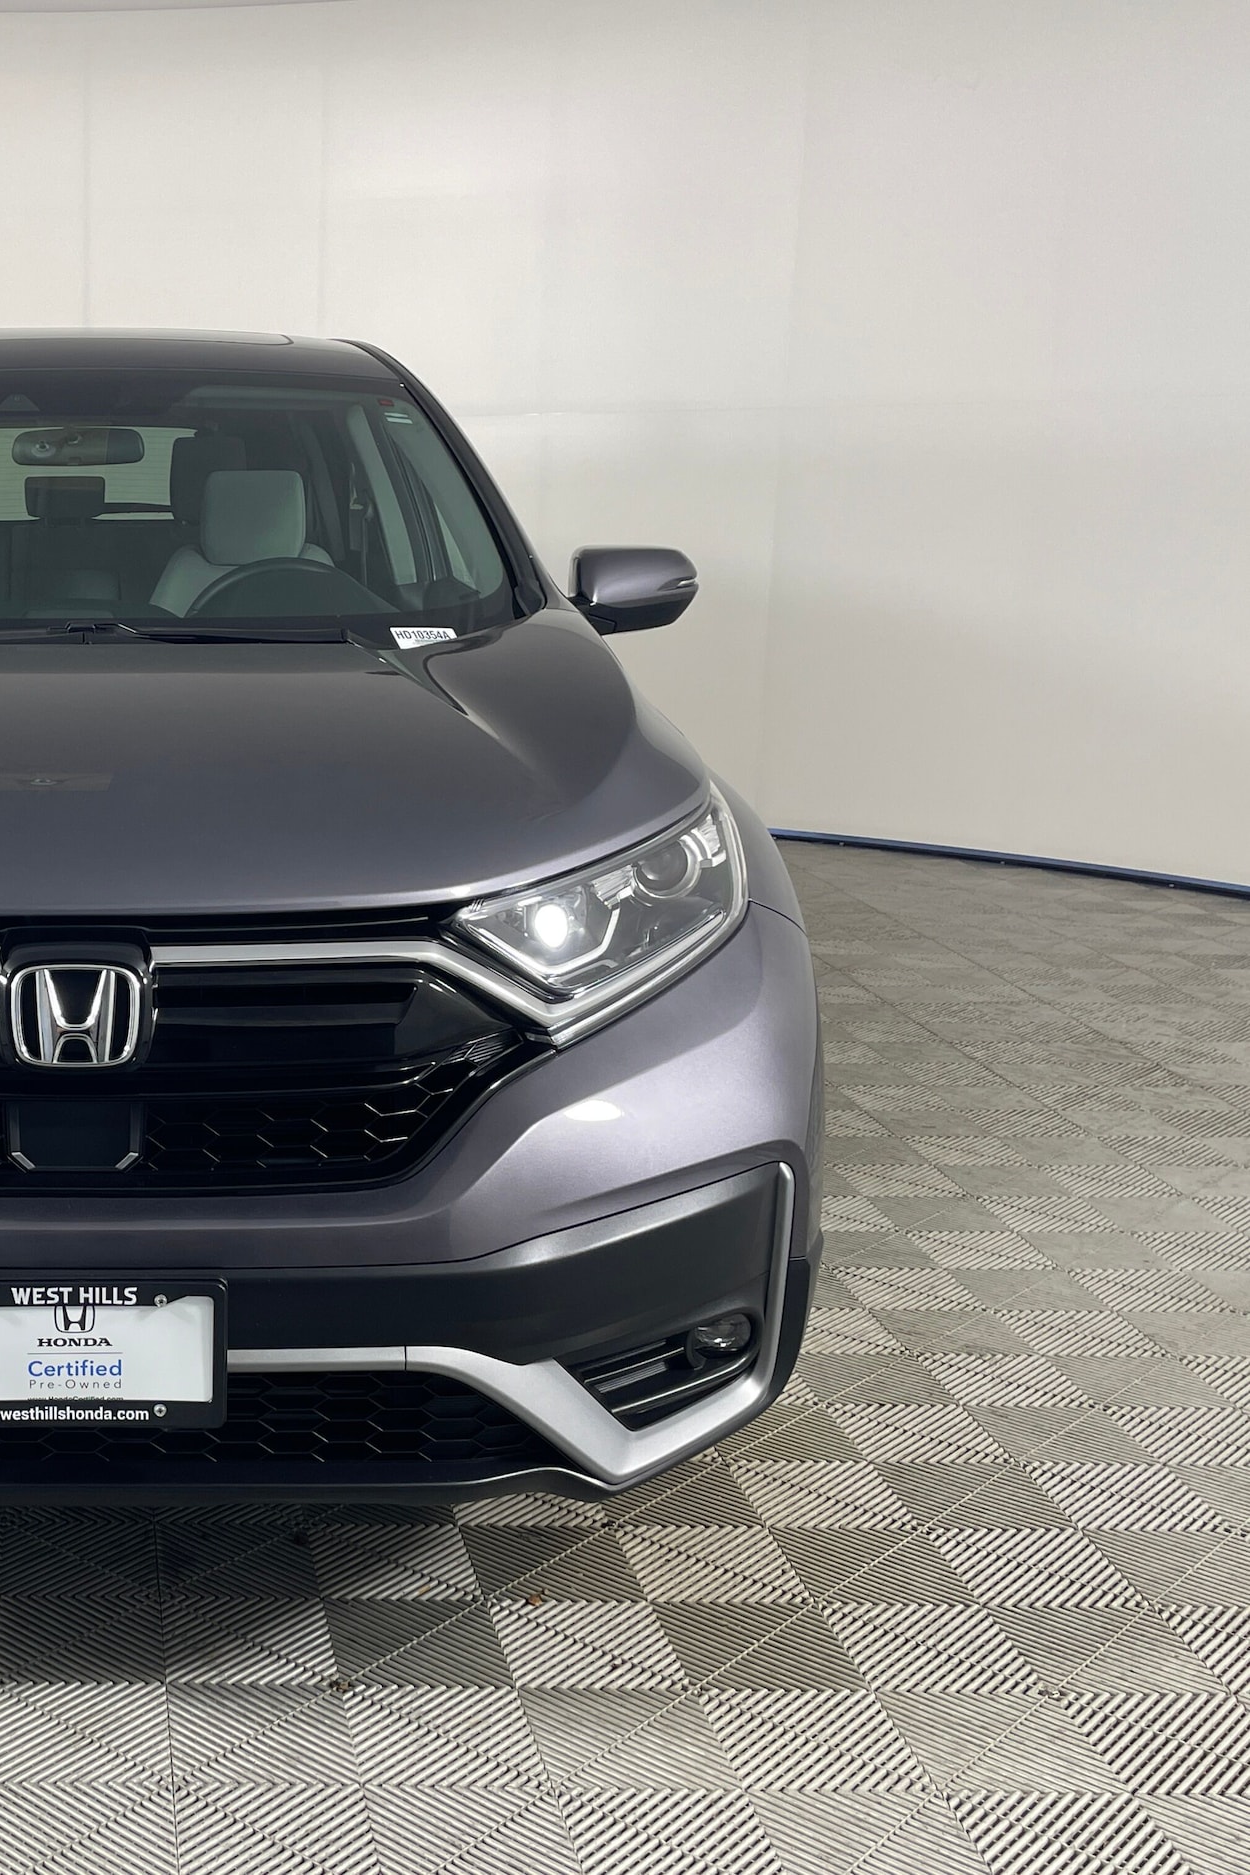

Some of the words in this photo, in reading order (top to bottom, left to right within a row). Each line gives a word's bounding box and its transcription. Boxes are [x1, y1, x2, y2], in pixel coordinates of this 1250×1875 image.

[394, 630, 451, 640] HD10354A
[11, 1287, 73, 1305] WEST
[79, 1287, 138, 1305] HILLS
[36, 1337, 113, 1348] HONDA
[28, 1359, 122, 1377] Certified
[29, 1379, 122, 1389] Pre-Owned
[0, 1406, 149, 1420] westhillshonda.com
